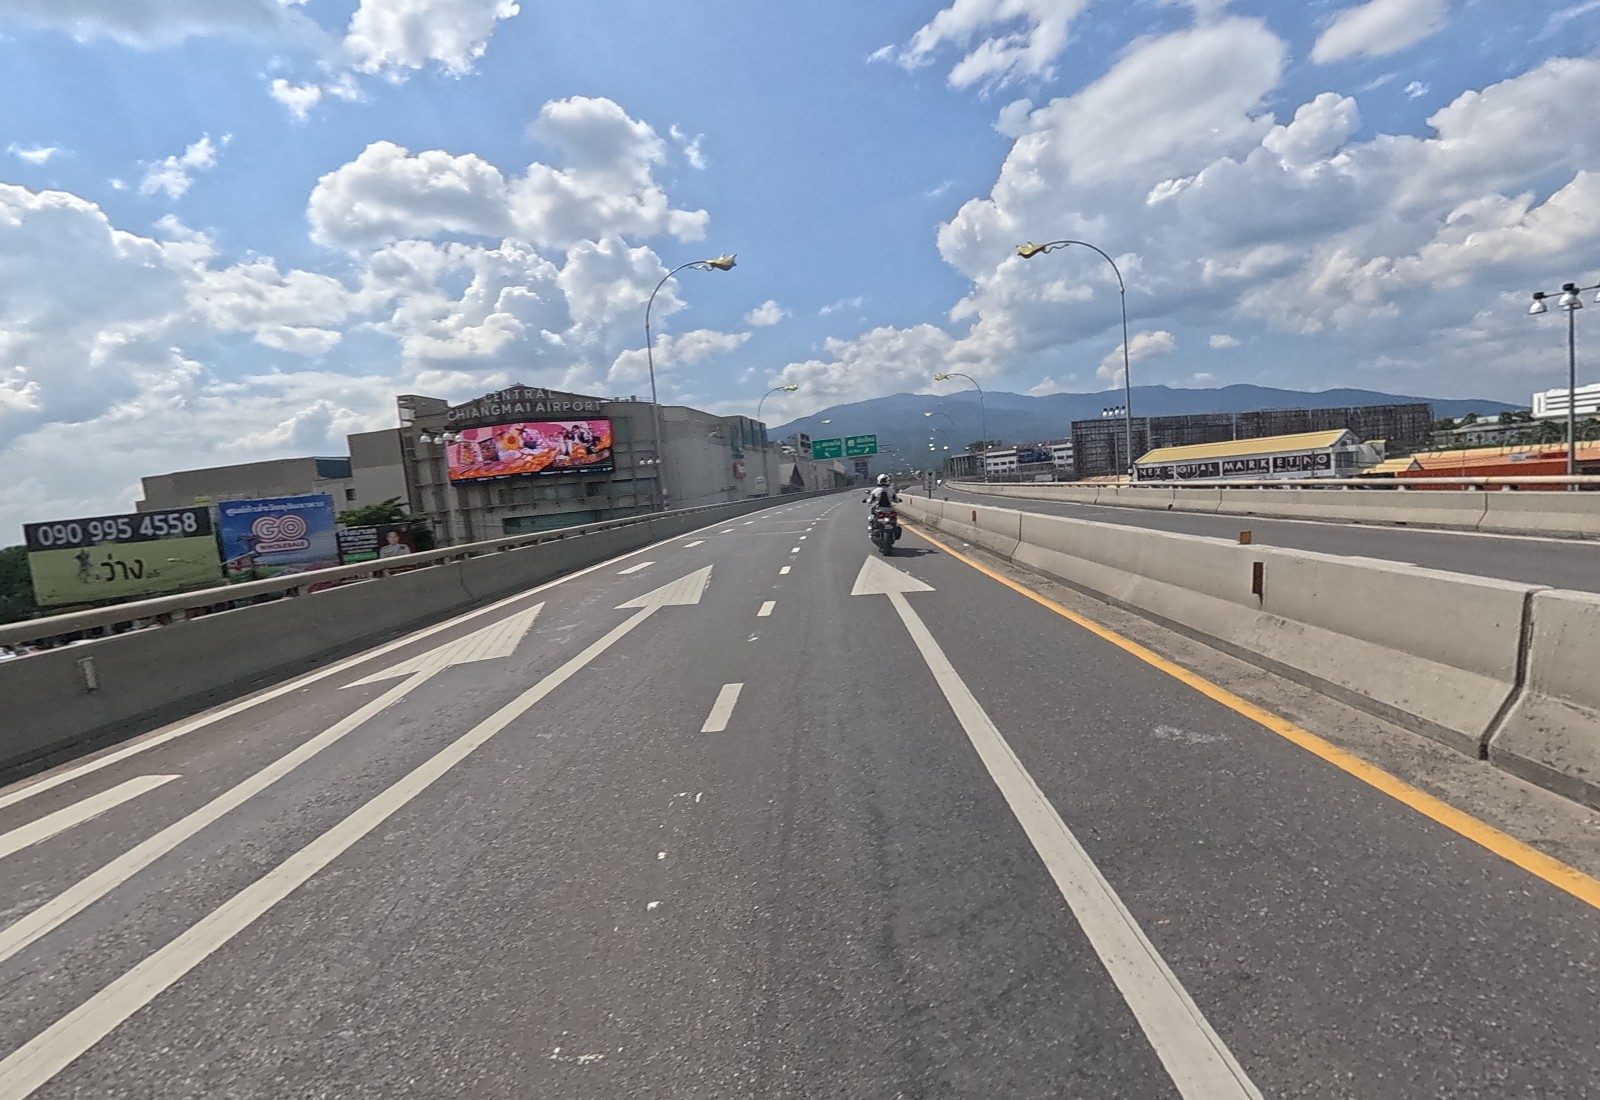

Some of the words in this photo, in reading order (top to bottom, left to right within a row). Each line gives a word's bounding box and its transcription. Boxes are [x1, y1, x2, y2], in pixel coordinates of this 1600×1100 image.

[484, 388, 556, 403] CENTRAL
[535, 400, 601, 413] AIRPORT
[38, 523, 83, 546] 090
[88, 517, 132, 542] 995
[139, 511, 198, 537] 4558
[252, 514, 307, 542] GO
[100, 553, 144, 582] ว่าง
